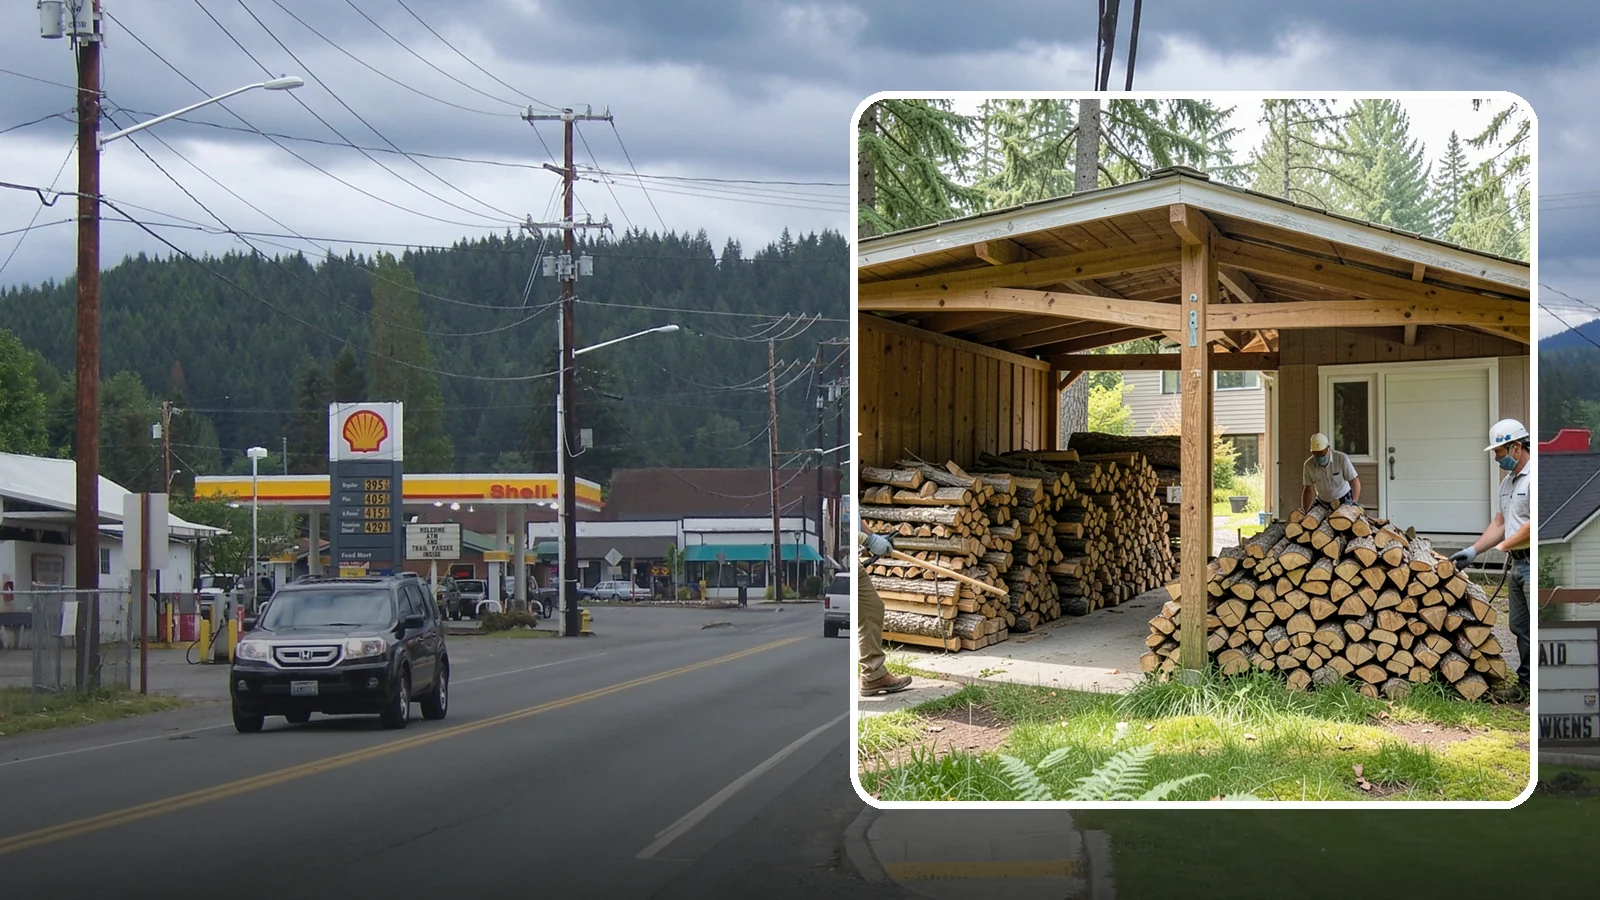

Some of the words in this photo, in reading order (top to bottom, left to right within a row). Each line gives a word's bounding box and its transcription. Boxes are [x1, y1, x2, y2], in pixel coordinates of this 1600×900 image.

[366, 480, 383, 490] 395
[490, 484, 547, 499] Shell
[366, 494, 383, 504] 405
[366, 508, 383, 518] 415
[366, 522, 383, 532] 429
